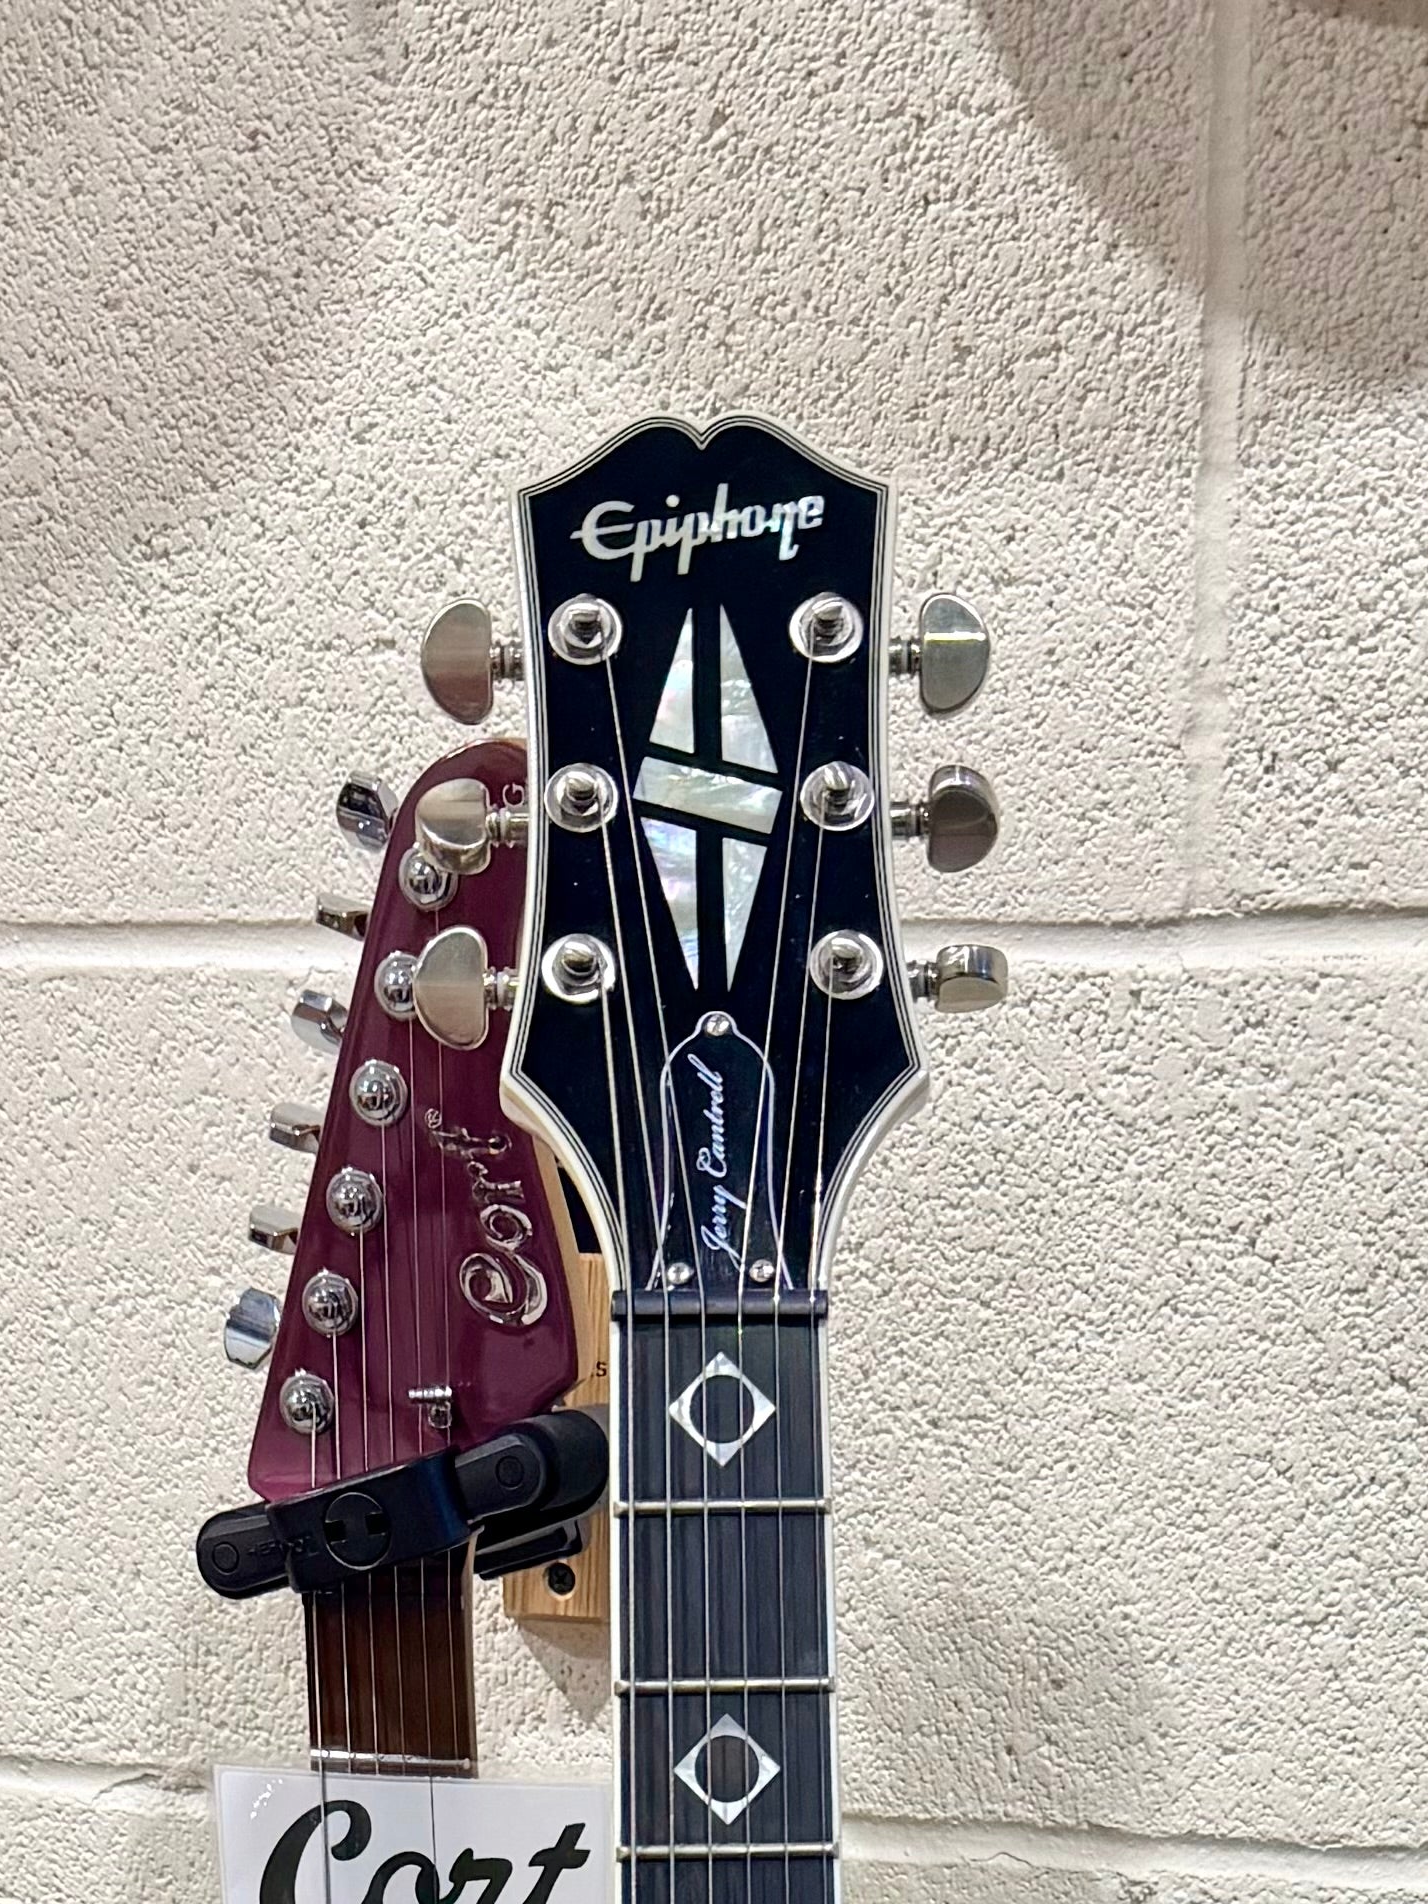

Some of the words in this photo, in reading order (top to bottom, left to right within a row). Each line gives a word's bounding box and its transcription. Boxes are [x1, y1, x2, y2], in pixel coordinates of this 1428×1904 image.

[570, 483, 825, 582] Epiphone
[687, 1053, 727, 1178] Cantrell
[431, 1127, 548, 1326] Cort
[700, 1184, 748, 1273] Jerry
